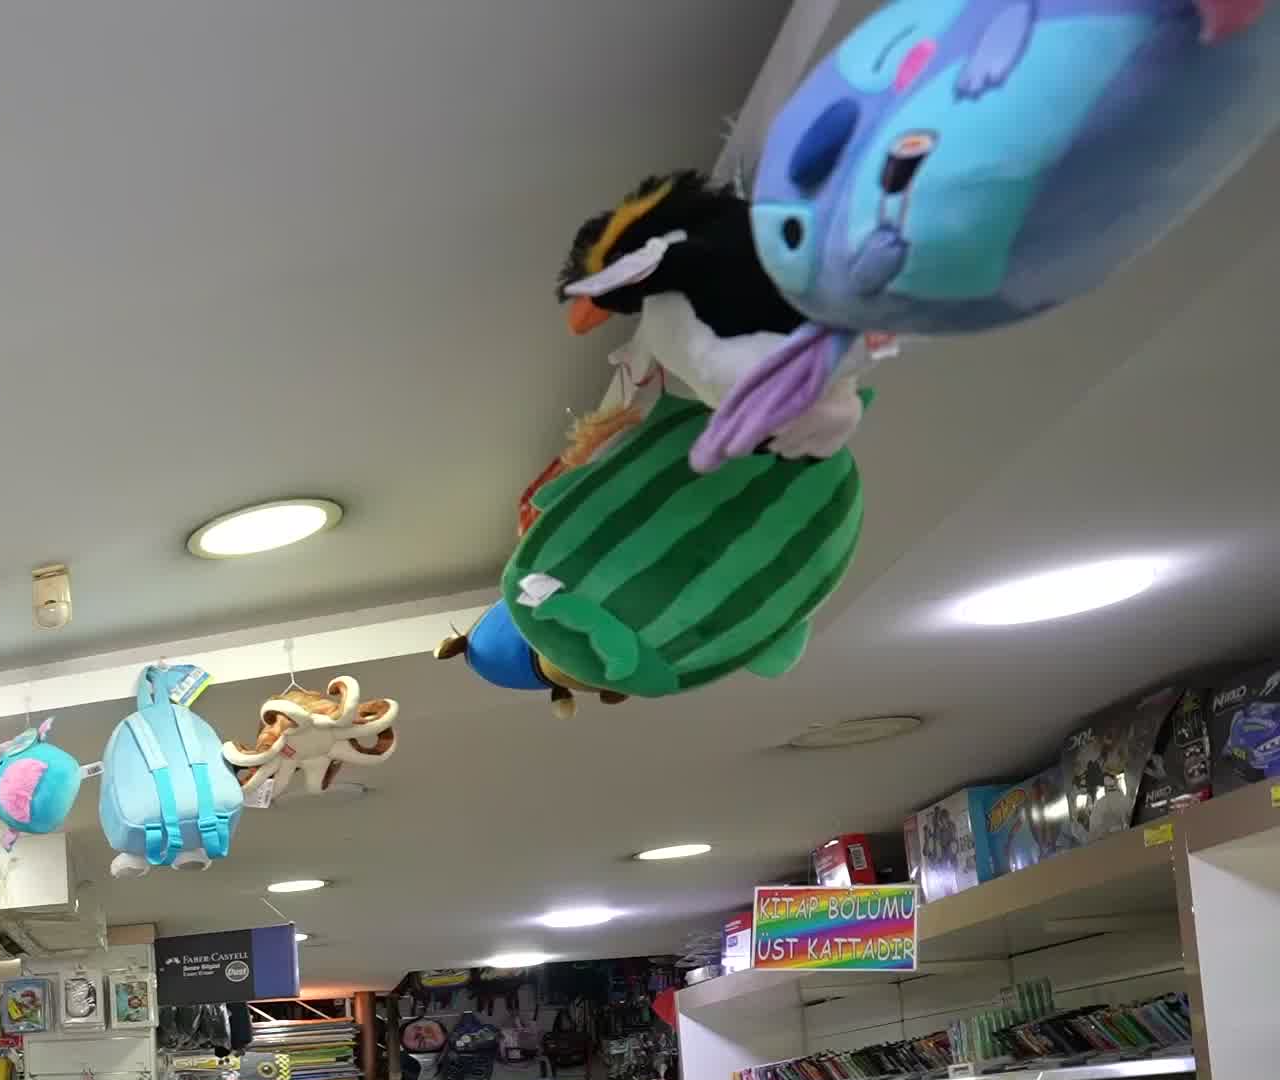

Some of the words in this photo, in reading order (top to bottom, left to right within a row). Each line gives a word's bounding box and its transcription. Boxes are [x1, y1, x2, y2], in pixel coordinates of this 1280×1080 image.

[759, 892, 820, 919] KİTAP
[828, 890, 914, 920] BÖLÜMÜ
[757, 931, 799, 961] ÜST
[807, 936, 915, 961] KATTADIR
